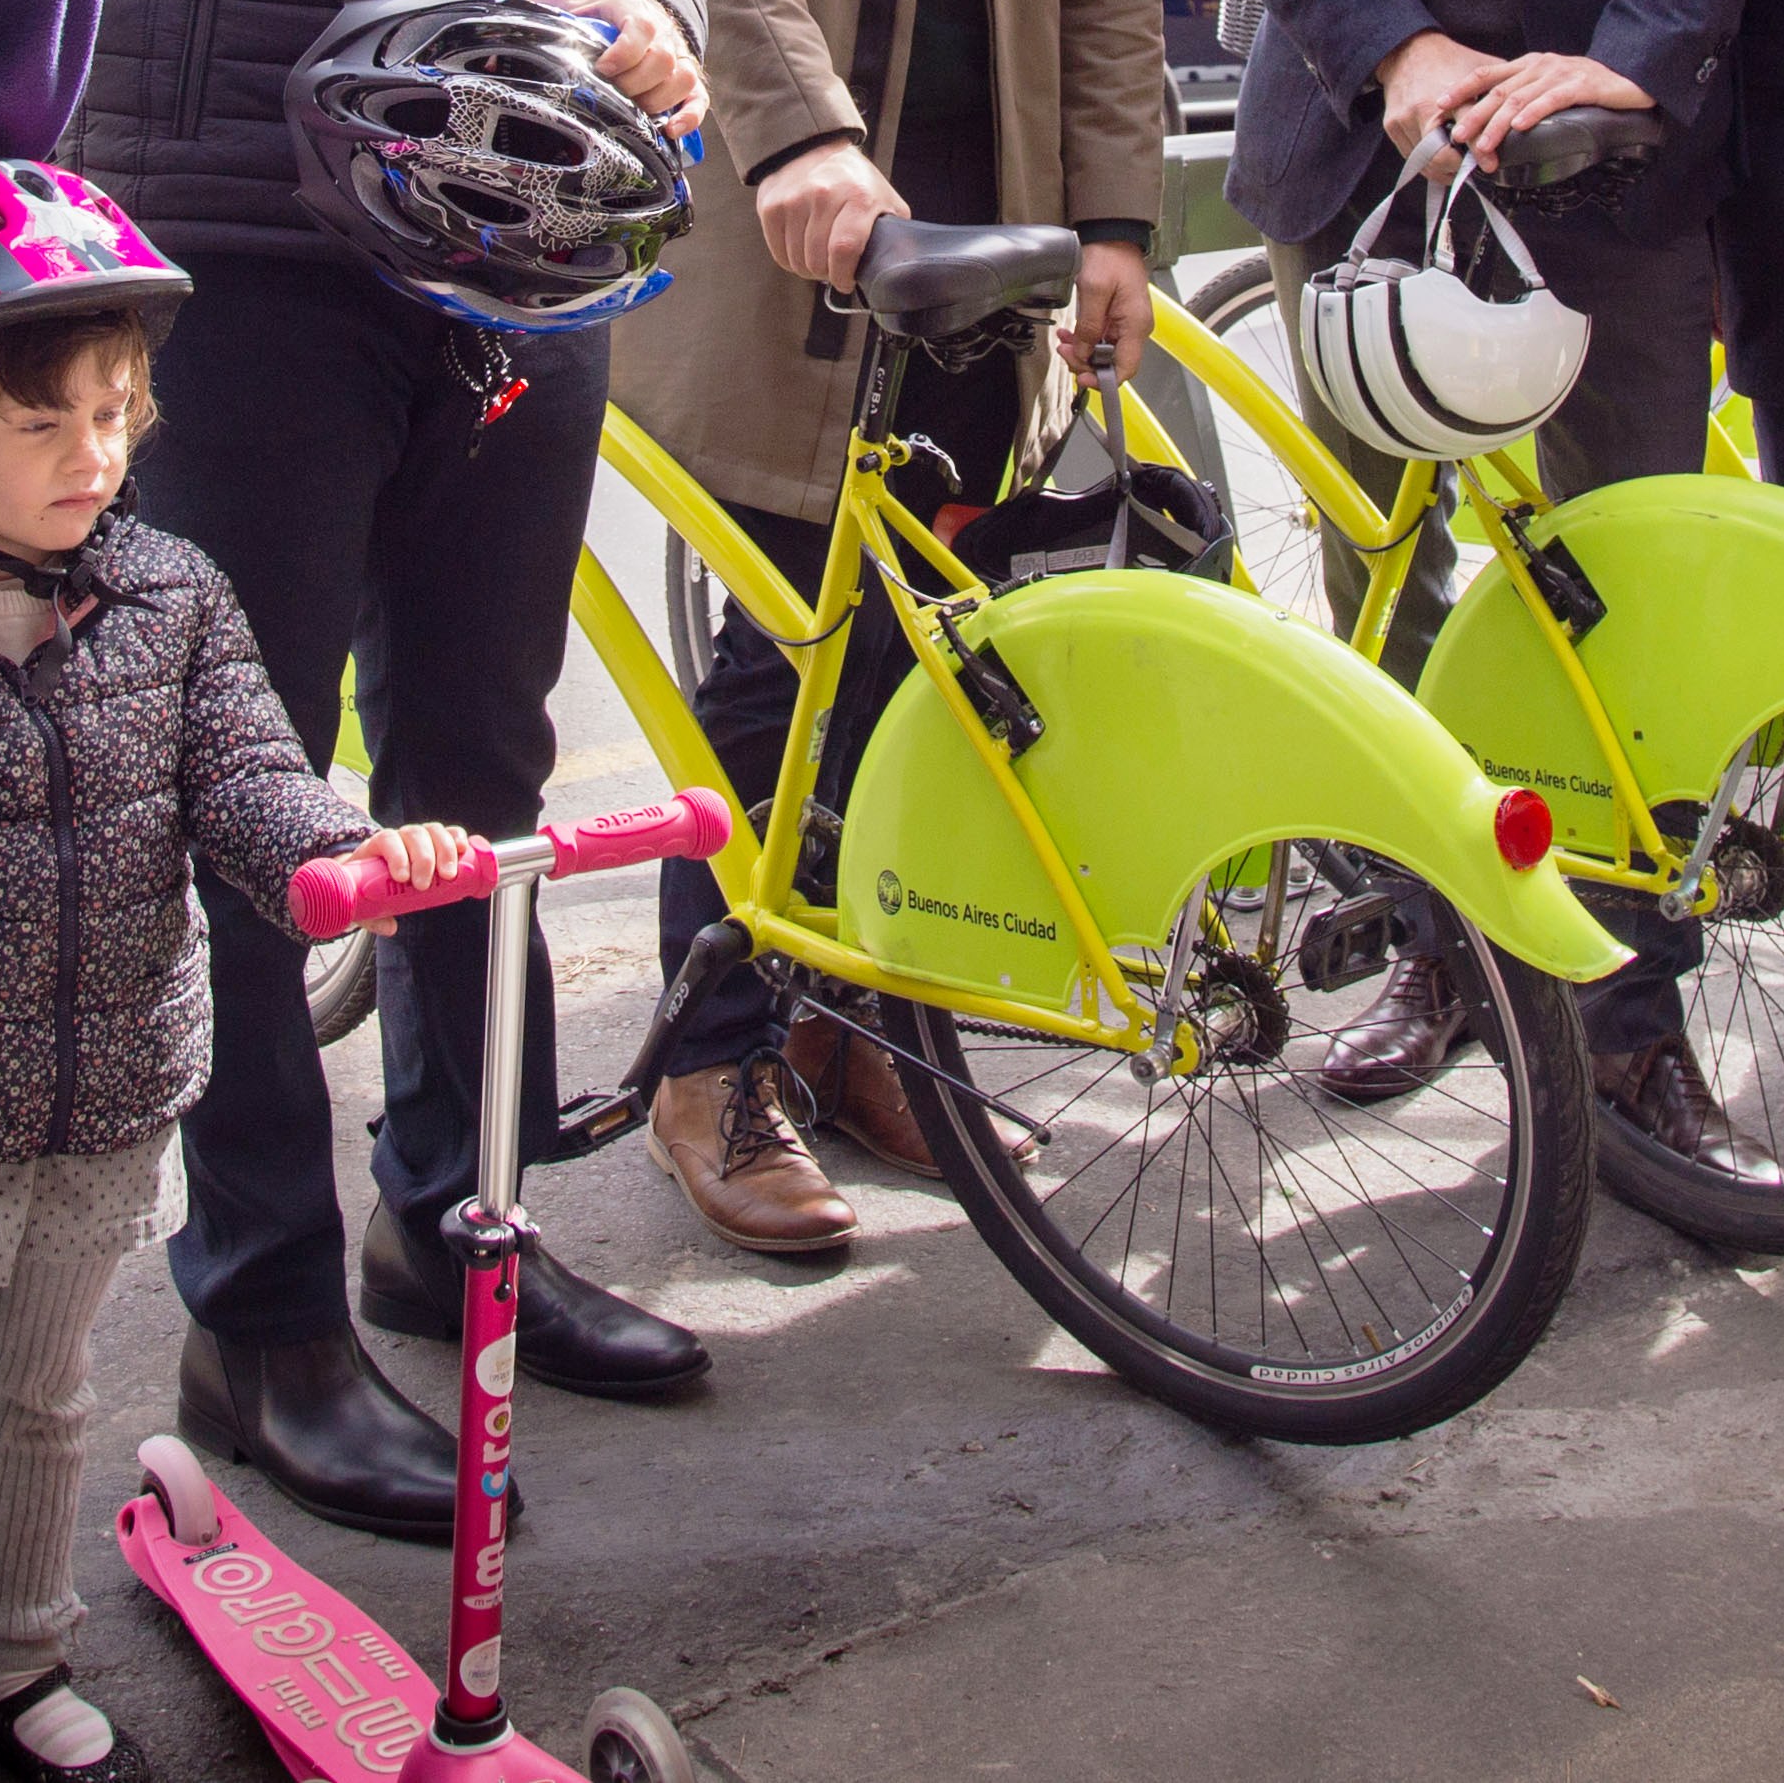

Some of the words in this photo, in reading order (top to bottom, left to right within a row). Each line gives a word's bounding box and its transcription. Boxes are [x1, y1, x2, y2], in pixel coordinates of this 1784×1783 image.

[1484, 759, 1531, 784] Buenos
[1534, 769, 1567, 790] Aires
[907, 889, 959, 920] Buenos
[962, 903, 1000, 929] Aires
[1003, 912, 1057, 941] Ciudad
[664, 981, 689, 1023] GCBA
[1403, 1298, 1463, 1355] Buenos
[1258, 1367, 1337, 1382] Ciudad
[1344, 1352, 1398, 1378] Aires
[340, 1631, 411, 1681] mini
[257, 1674, 329, 1730] mini
